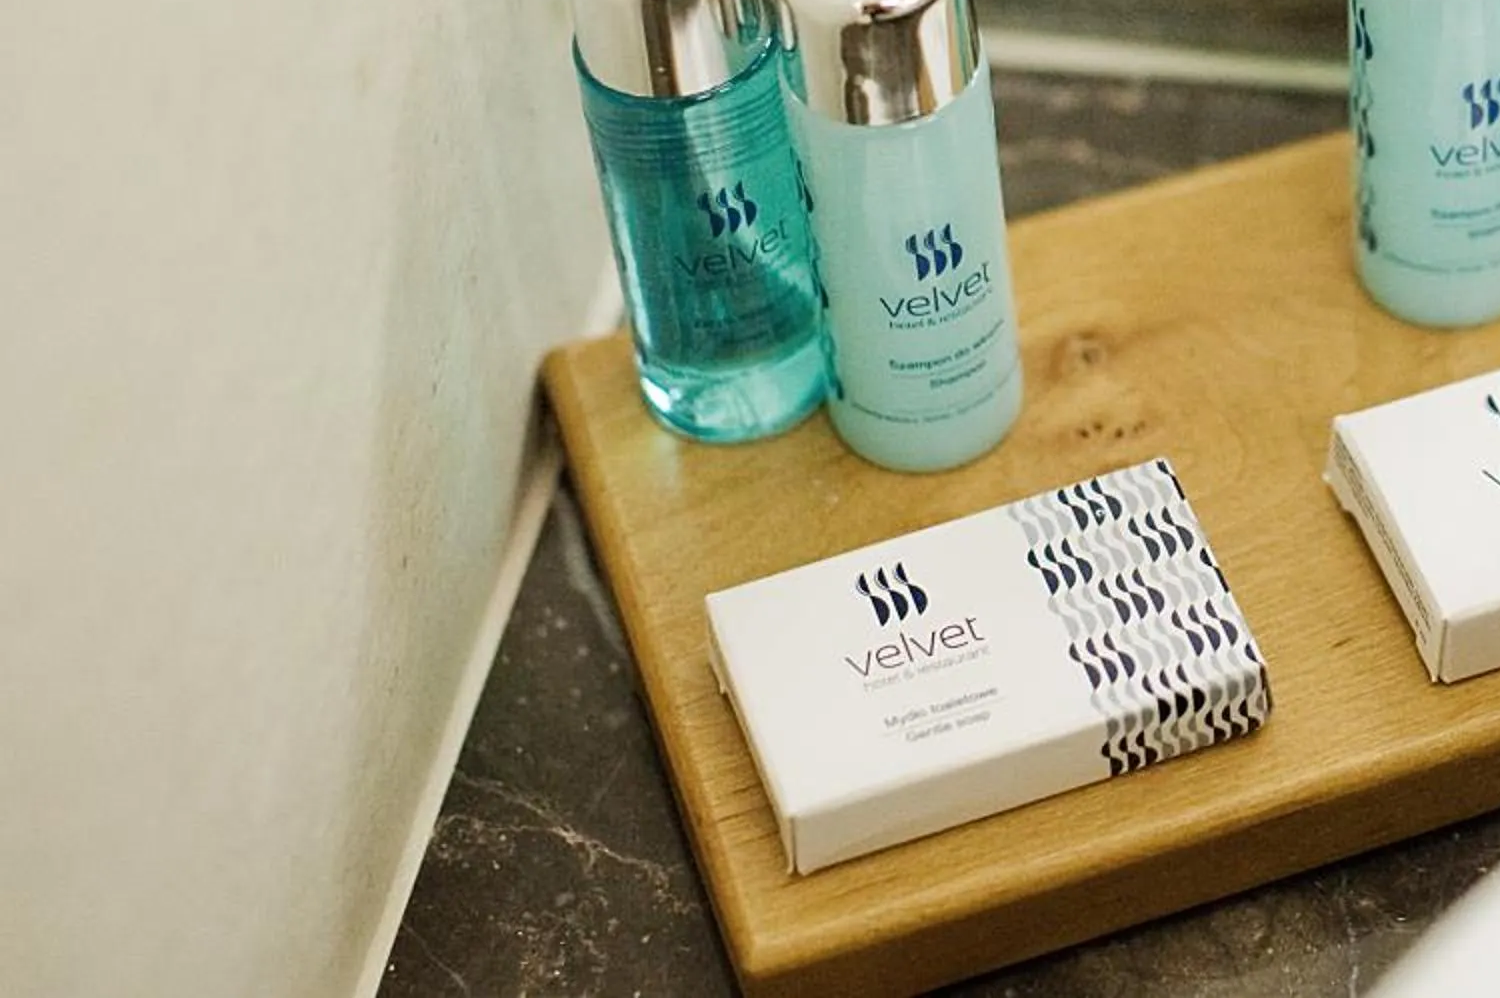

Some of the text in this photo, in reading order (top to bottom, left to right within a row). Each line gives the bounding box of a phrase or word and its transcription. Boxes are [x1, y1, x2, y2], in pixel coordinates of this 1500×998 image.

[674, 219, 789, 277] velvet
[879, 261, 990, 319] velvet
[844, 617, 986, 678] velvet
